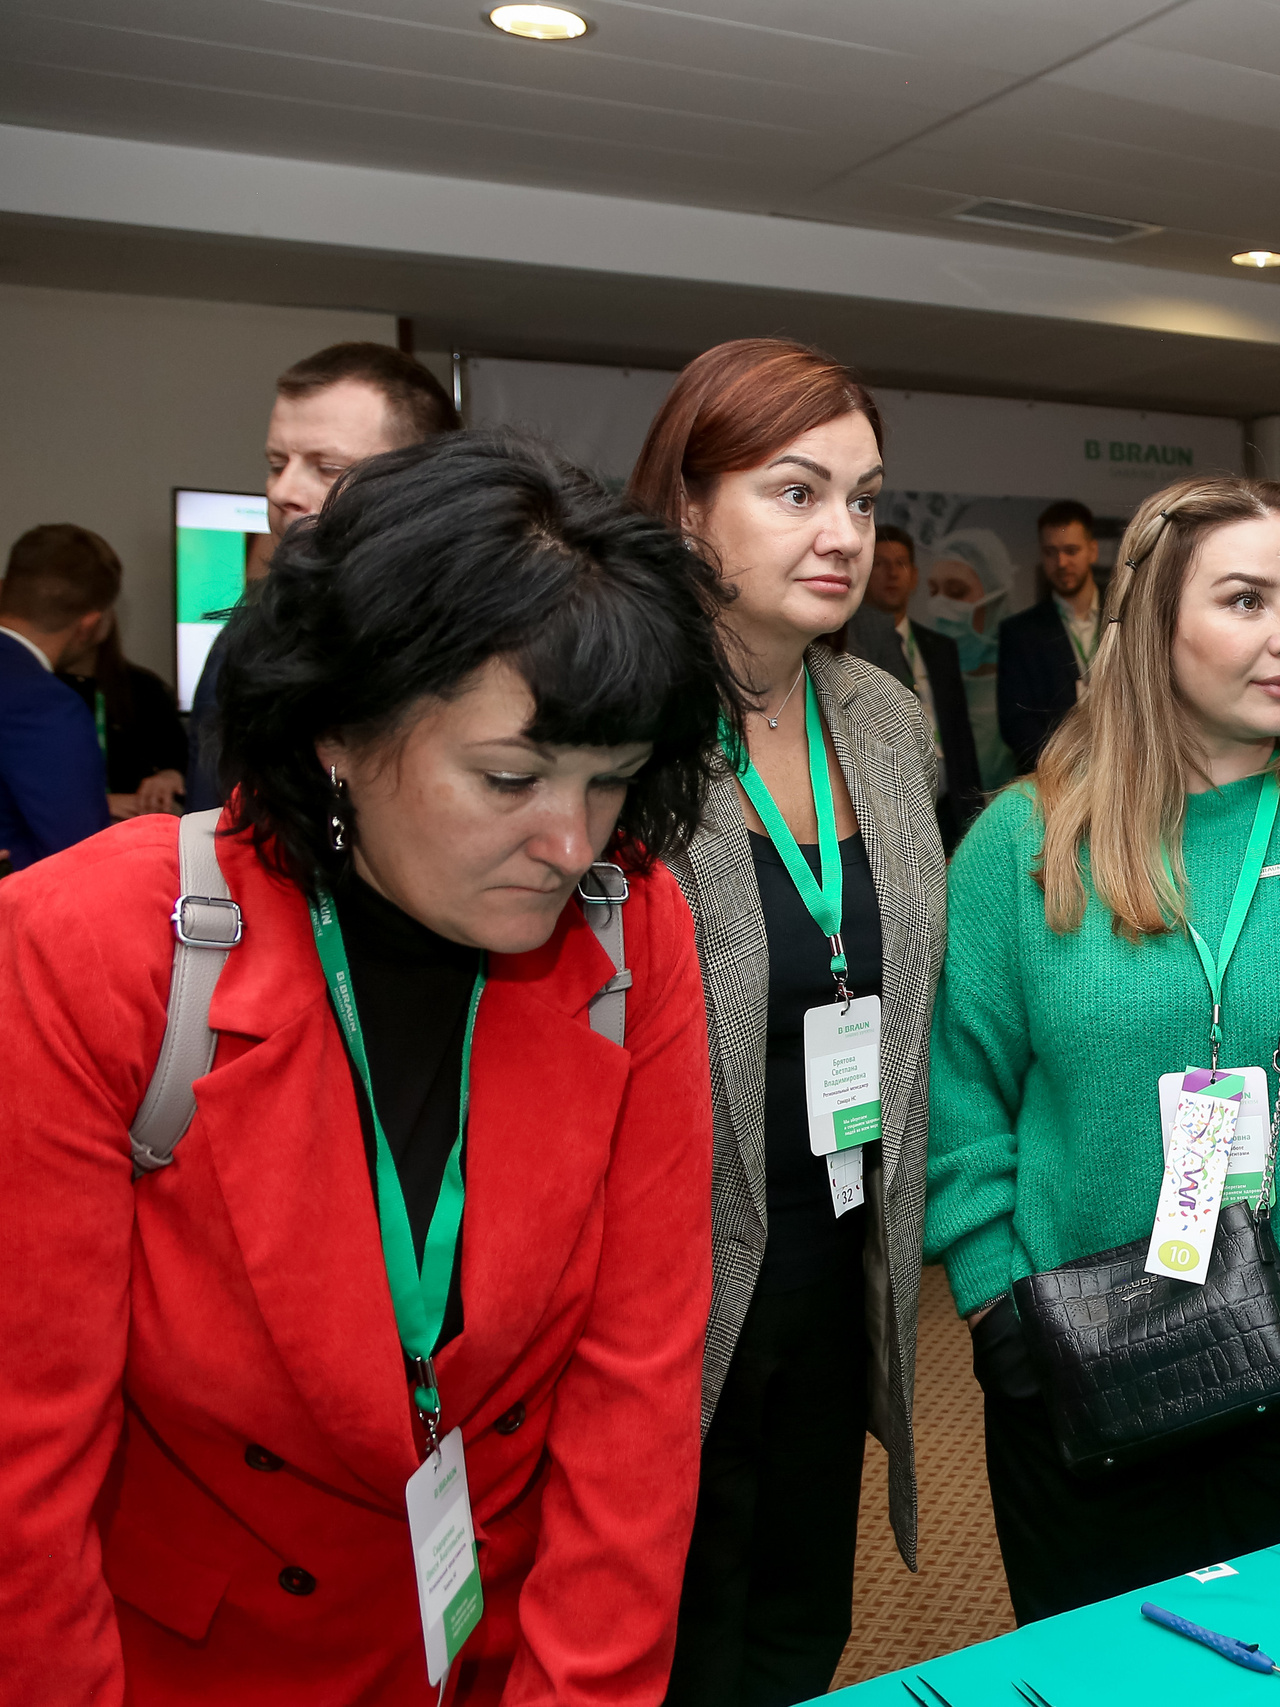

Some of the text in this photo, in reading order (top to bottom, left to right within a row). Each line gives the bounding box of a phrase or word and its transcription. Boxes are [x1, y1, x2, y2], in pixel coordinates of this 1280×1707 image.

[1084, 439, 1194, 467] B BRAUN
[339, 983, 357, 1032] BRAUN
[838, 1021, 870, 1035] B BRAUN
[832, 1055, 856, 1068] Брятова
[831, 1064, 858, 1077] Светлана
[824, 1072, 867, 1088] Владимировна
[842, 1188, 853, 1205] 32
[1169, 1245, 1190, 1265] 10
